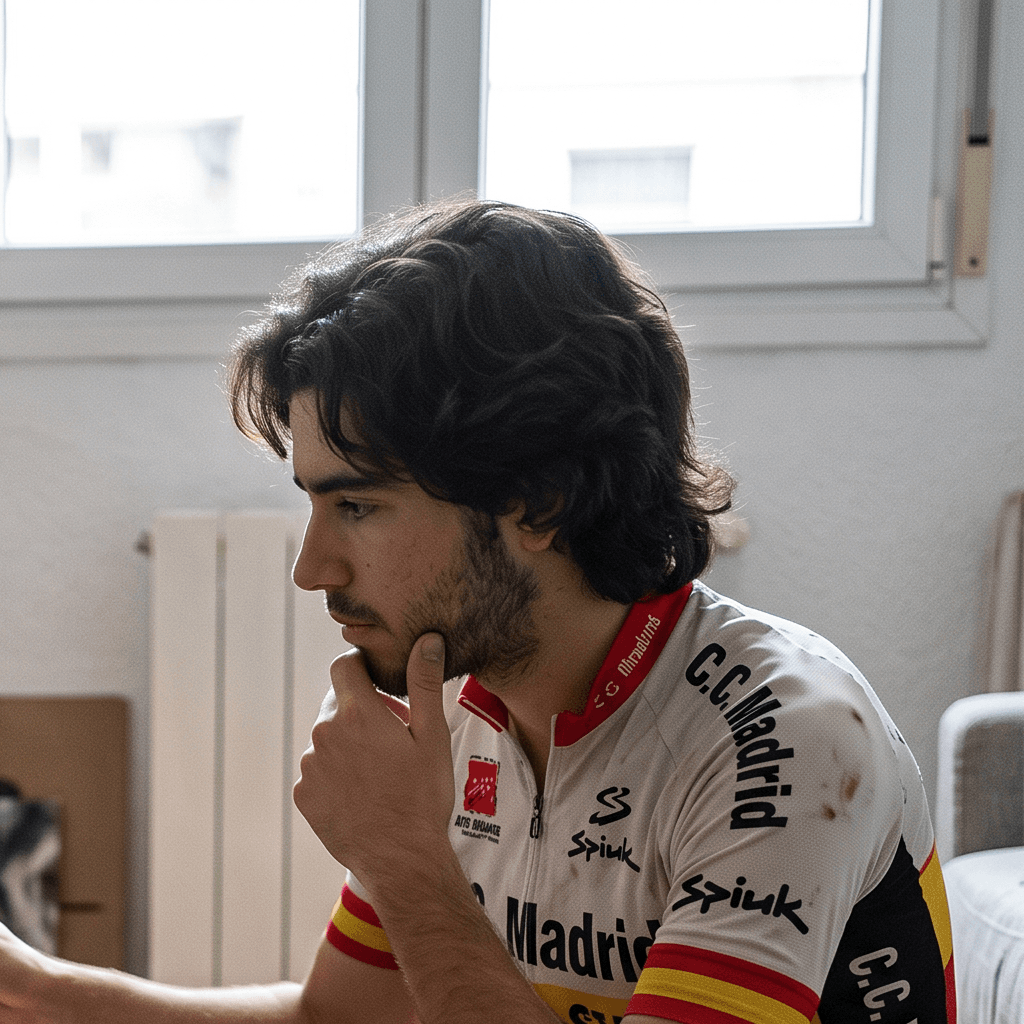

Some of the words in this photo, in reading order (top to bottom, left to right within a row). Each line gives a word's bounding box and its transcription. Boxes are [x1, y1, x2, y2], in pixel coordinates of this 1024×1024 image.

[568, 829, 641, 873] Spiuk
[672, 874, 809, 935] Spiuk
[849, 946, 911, 1022] C.C.
